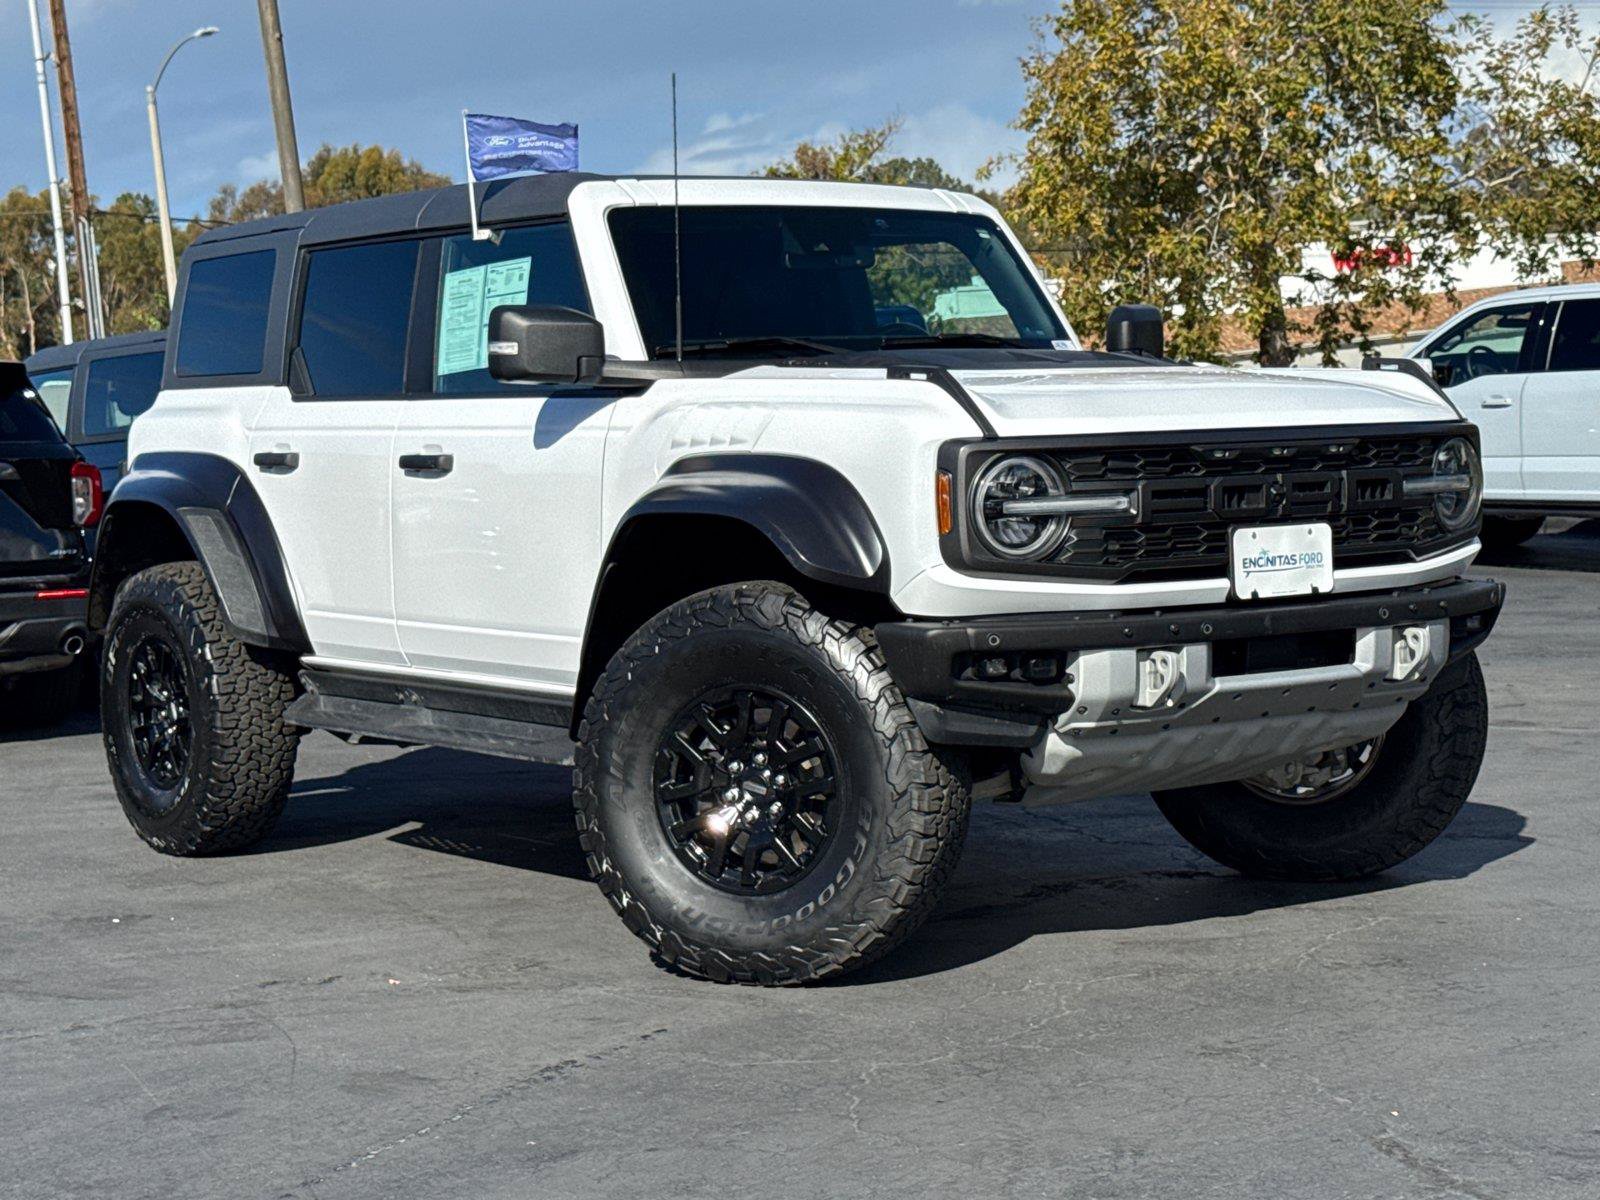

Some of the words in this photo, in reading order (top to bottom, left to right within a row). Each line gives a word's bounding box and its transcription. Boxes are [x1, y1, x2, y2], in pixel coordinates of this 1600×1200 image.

[1140, 469, 1402, 524] FORD
[1242, 553, 1298, 569] ENCINITAS
[1299, 552, 1323, 564] FORD
